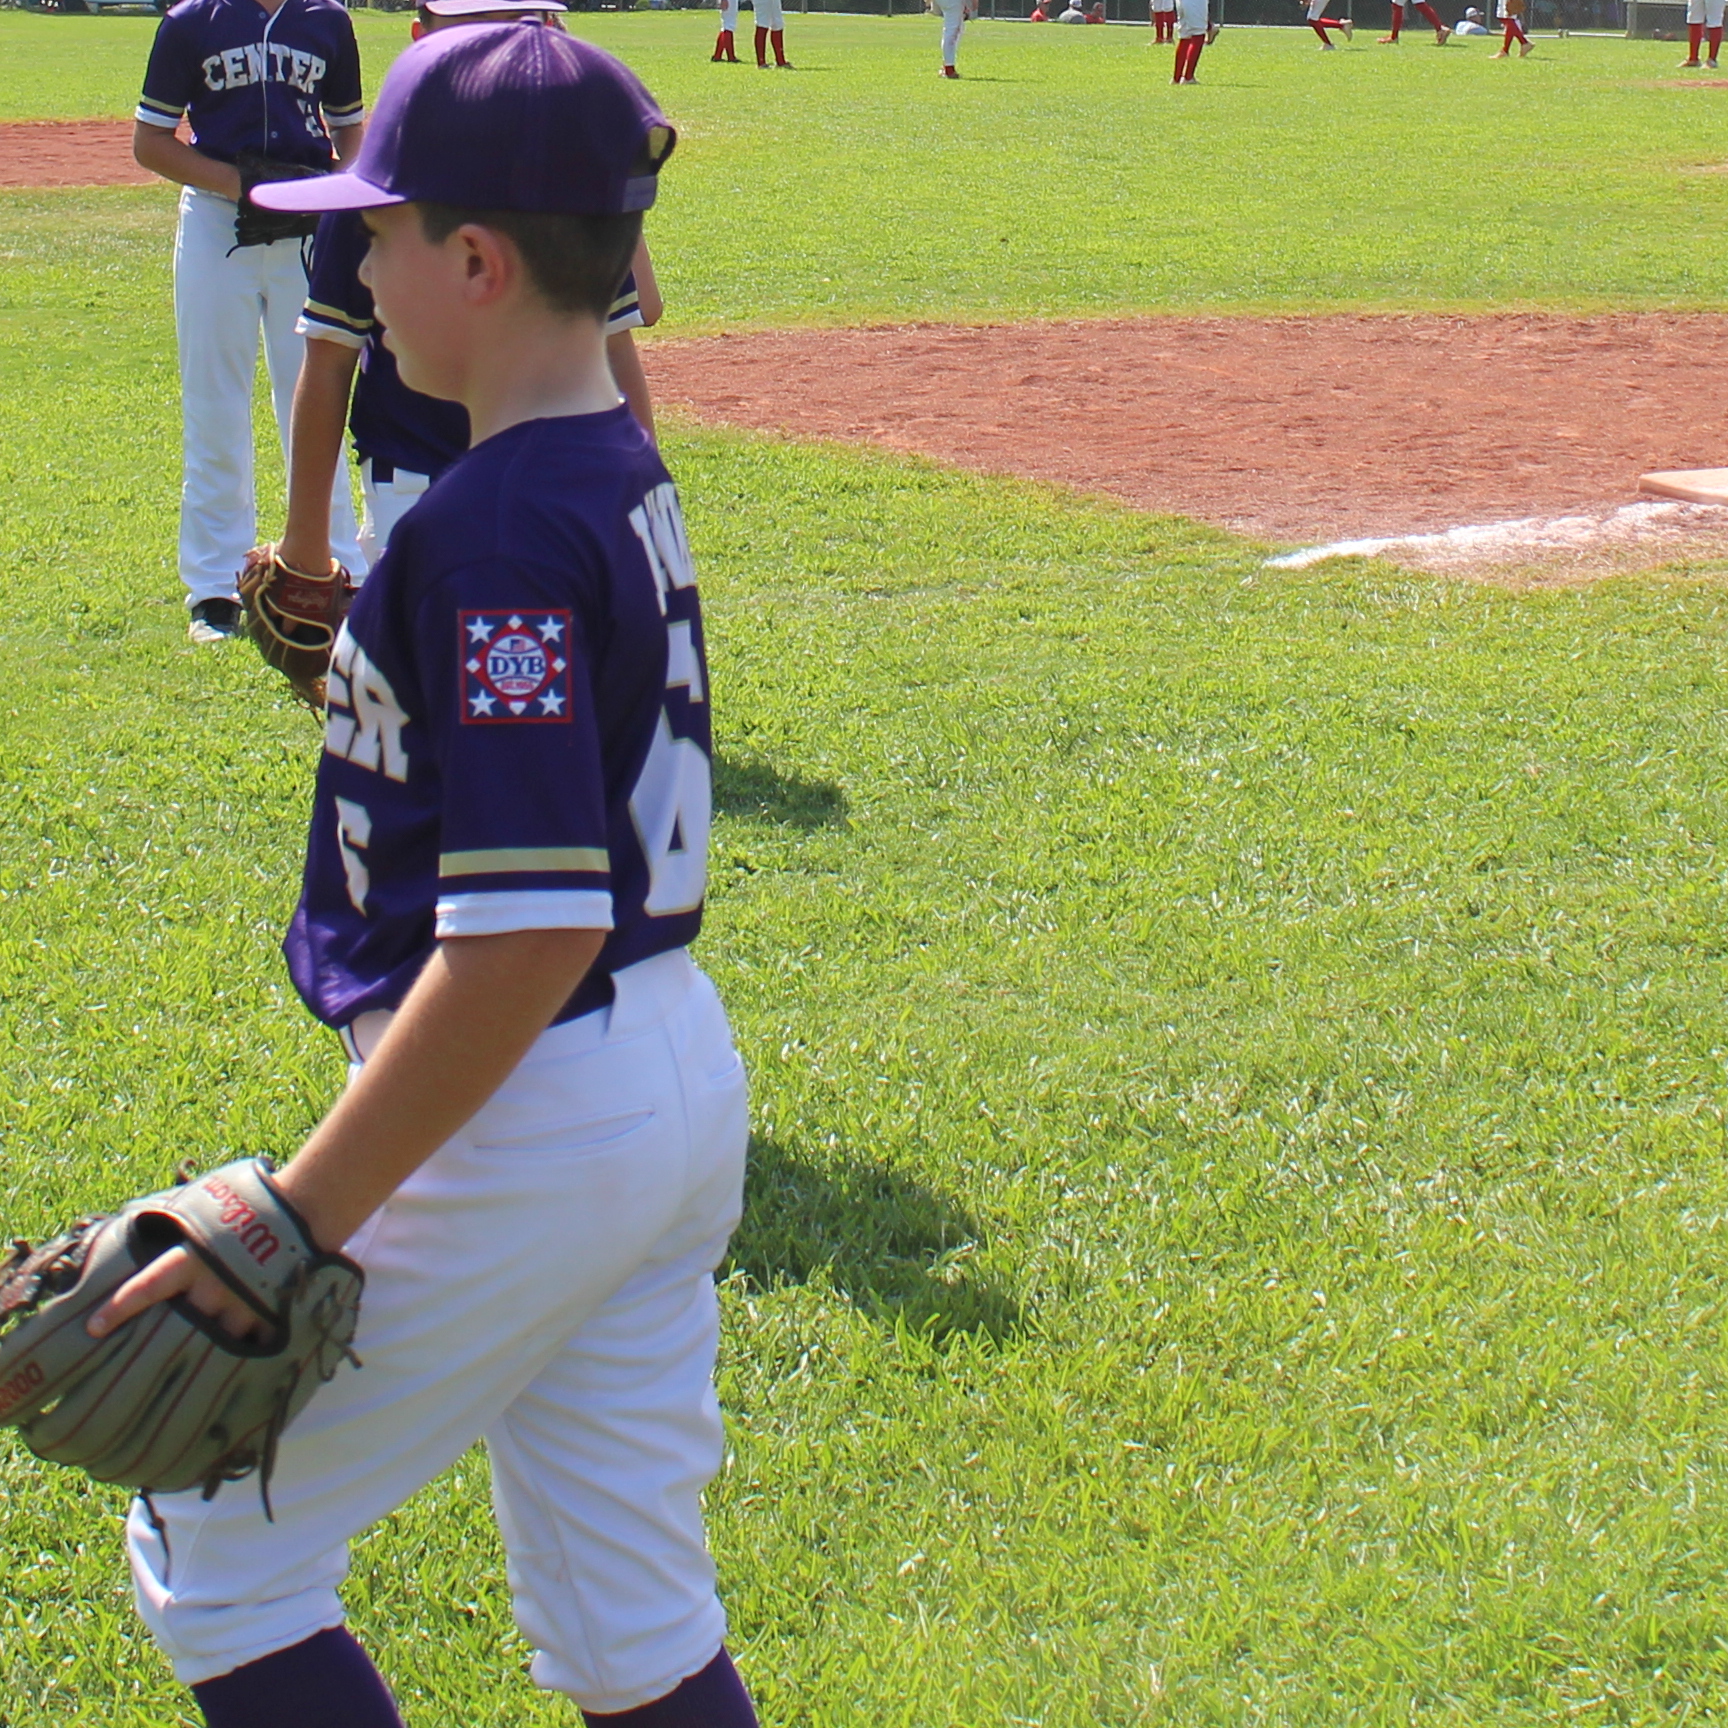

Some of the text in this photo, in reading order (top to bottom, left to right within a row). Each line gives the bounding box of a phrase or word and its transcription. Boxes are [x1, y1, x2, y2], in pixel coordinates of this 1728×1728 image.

[202, 41, 326, 94] CENTER
[489, 656, 546, 676] DYB
[202, 1176, 280, 1267] Wilson
